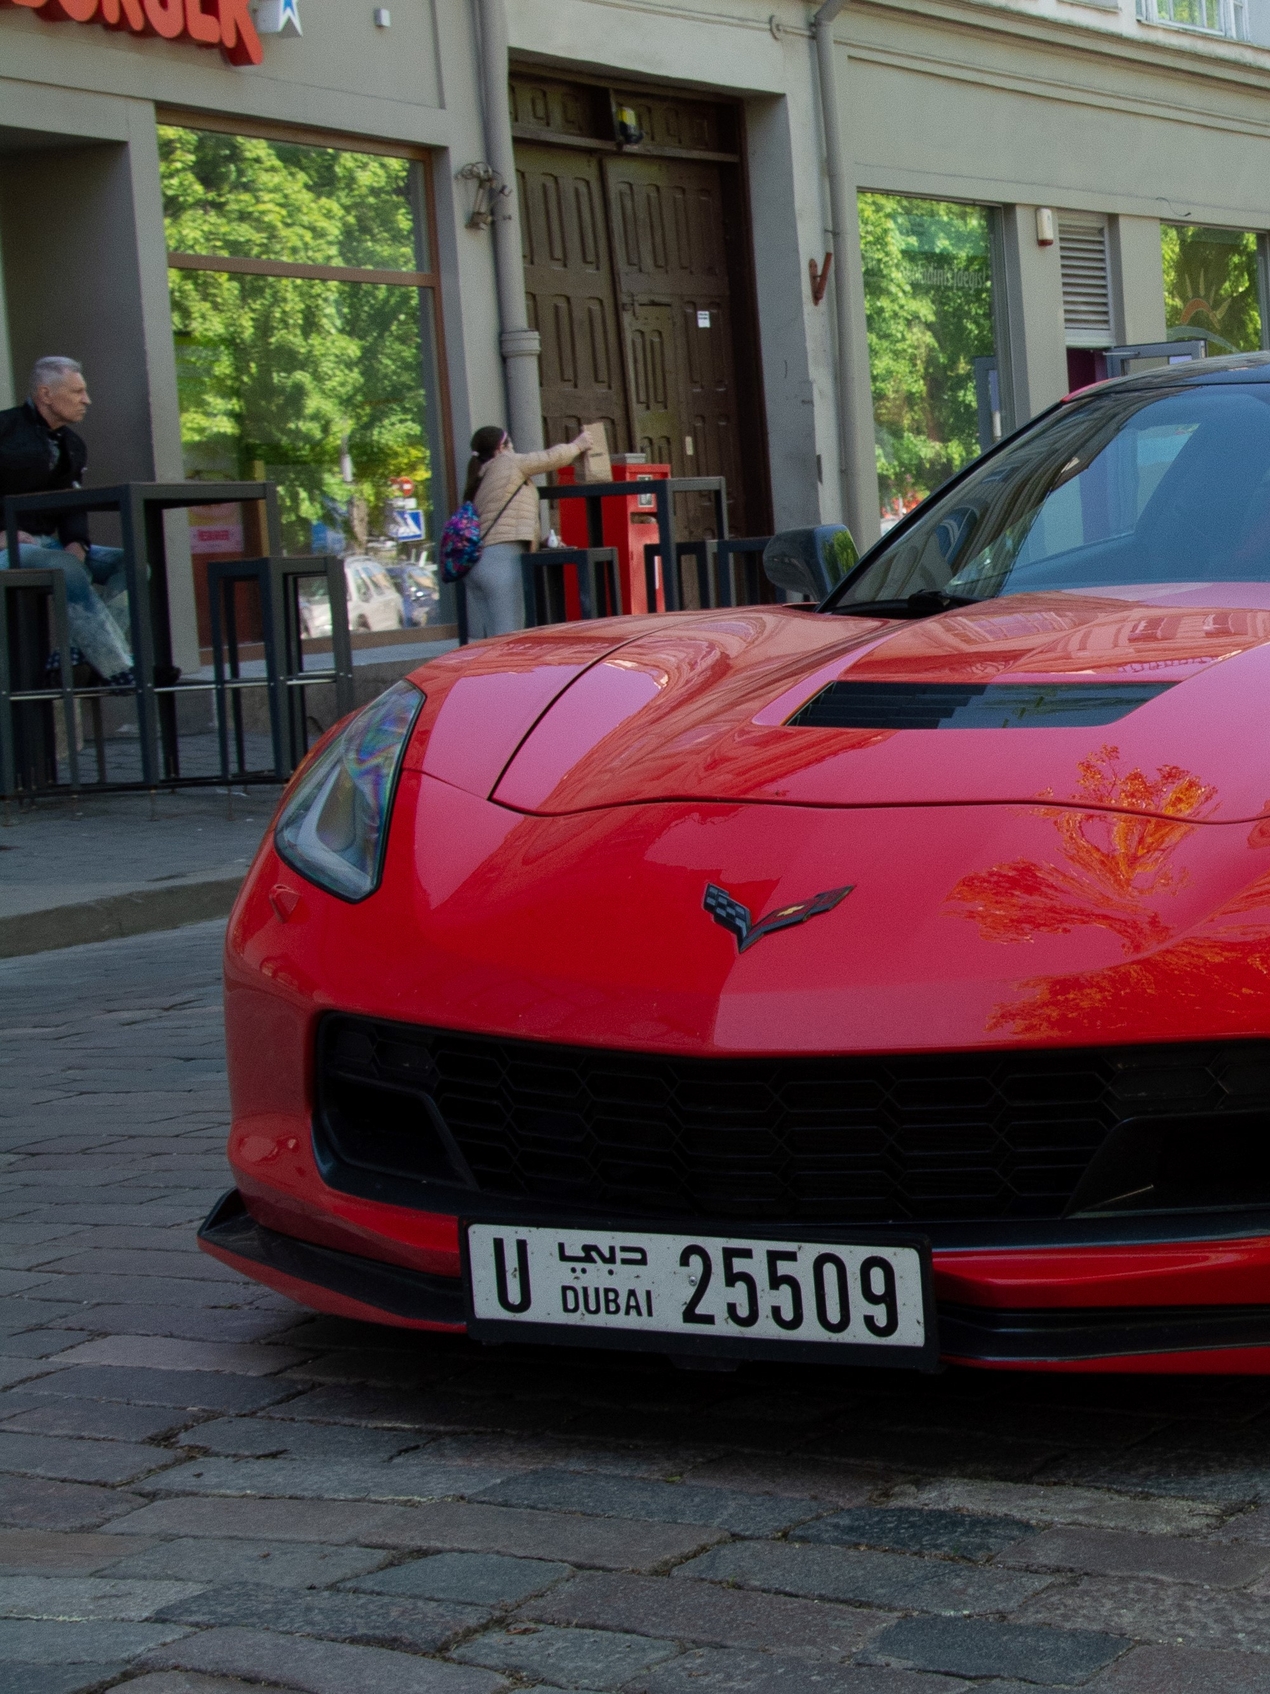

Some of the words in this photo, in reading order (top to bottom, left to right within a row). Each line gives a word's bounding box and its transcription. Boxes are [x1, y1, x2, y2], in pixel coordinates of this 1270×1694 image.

[493, 1237, 532, 1314] U
[557, 1242, 648, 1276] دبي
[561, 1285, 653, 1317] DUBAI
[678, 1244, 900, 1338] 25509
